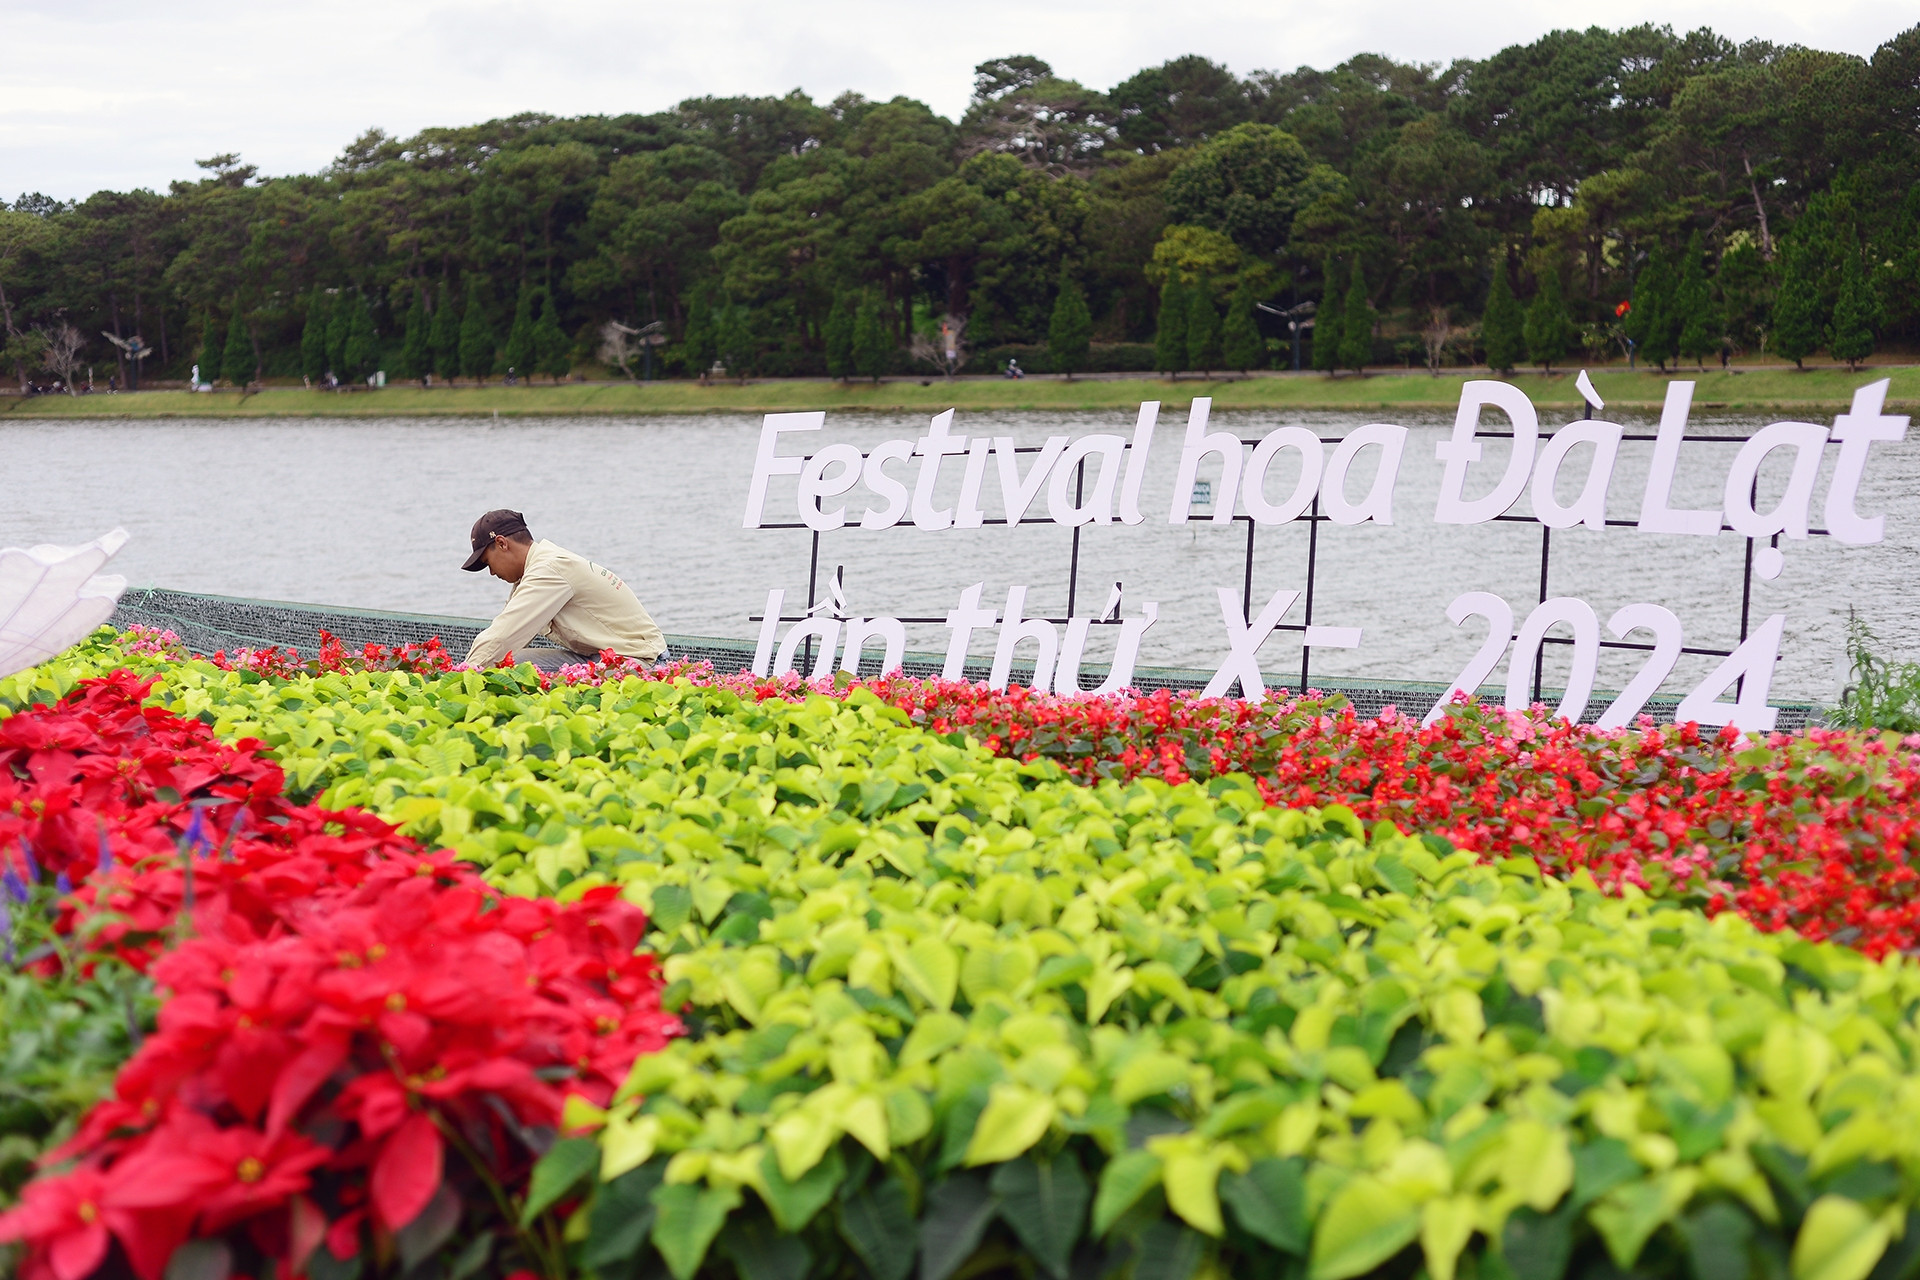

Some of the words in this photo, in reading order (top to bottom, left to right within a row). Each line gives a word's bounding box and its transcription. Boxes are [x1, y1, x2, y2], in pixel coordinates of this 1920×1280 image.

[743, 401, 1161, 531] Festival
[1168, 397, 1408, 526] hoa
[1434, 369, 1624, 531] Đà
[1637, 378, 1911, 580] Lạt
[942, 581, 1158, 697] thứ
[1421, 591, 1786, 746] 2024
